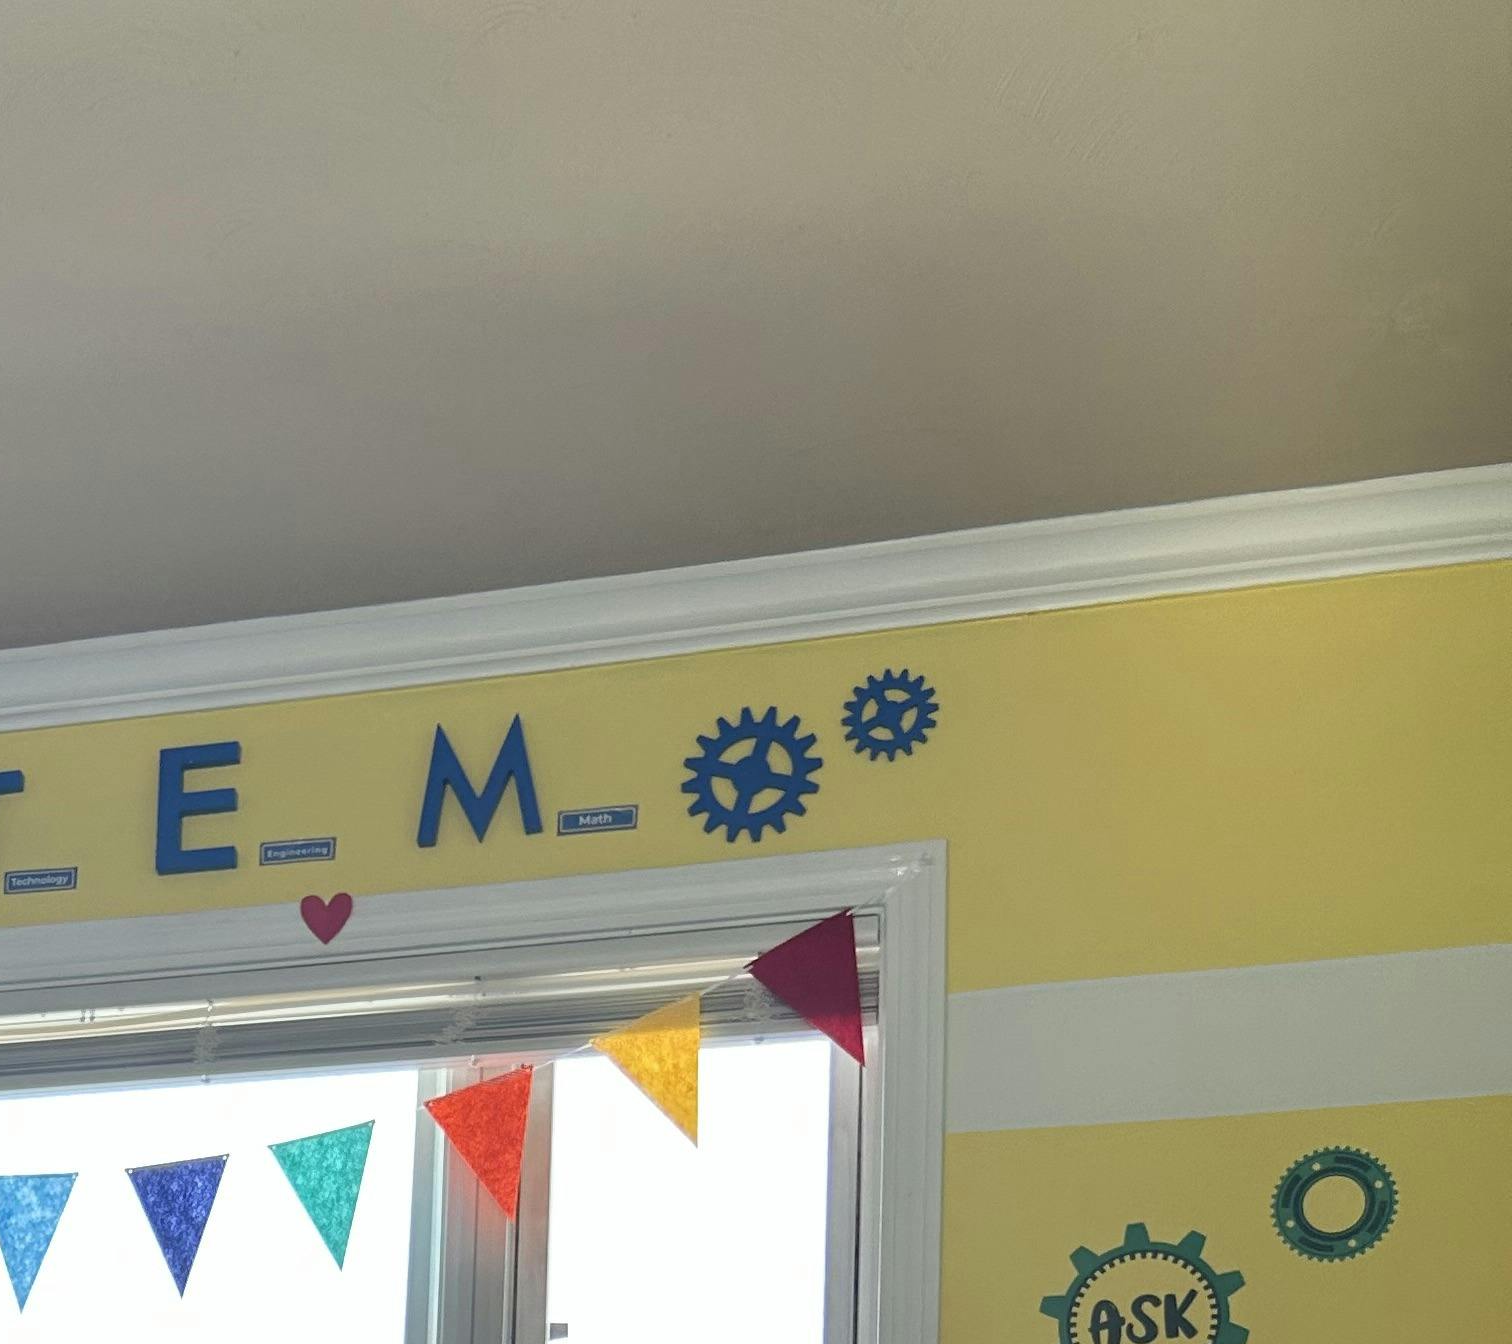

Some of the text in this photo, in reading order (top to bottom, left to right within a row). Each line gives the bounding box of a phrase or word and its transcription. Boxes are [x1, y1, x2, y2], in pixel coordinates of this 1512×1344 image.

[579, 813, 612, 826] Math
[267, 846, 329, 859] Engineering
[10, 874, 69, 887] Technology
